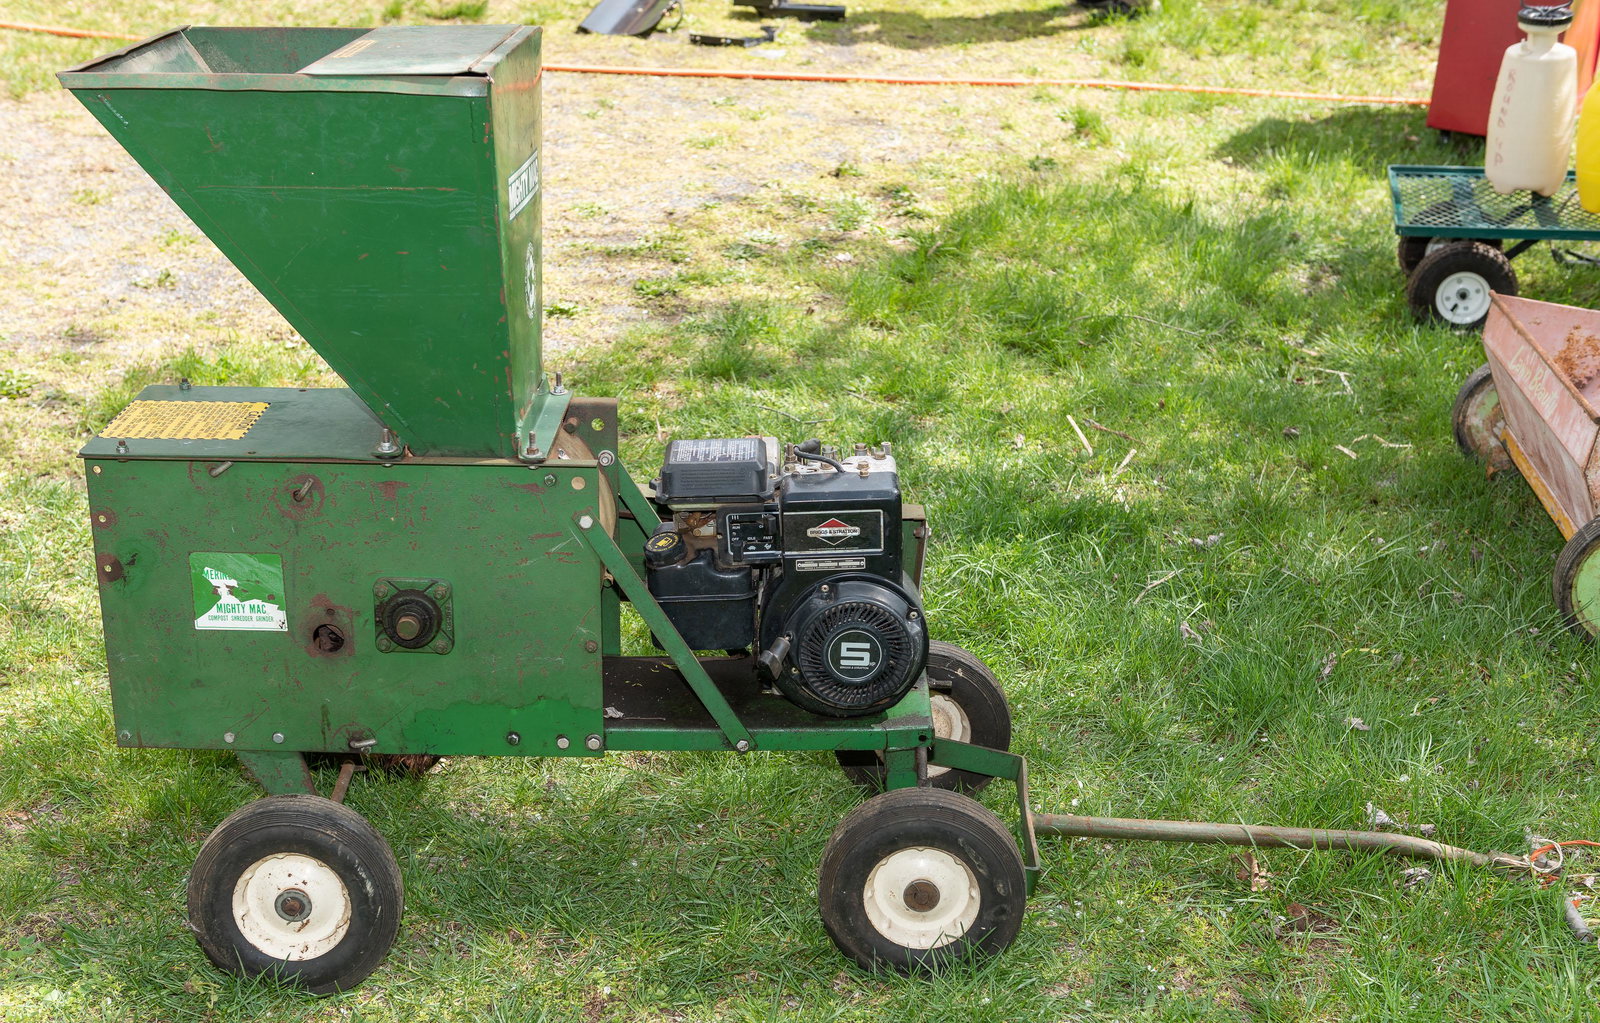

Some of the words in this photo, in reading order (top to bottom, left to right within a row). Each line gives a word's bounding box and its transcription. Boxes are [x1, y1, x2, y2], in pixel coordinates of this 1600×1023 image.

[216, 604, 245, 614] MIGHTY
[249, 604, 267, 614] MAC
[840, 642, 870, 666] 5
